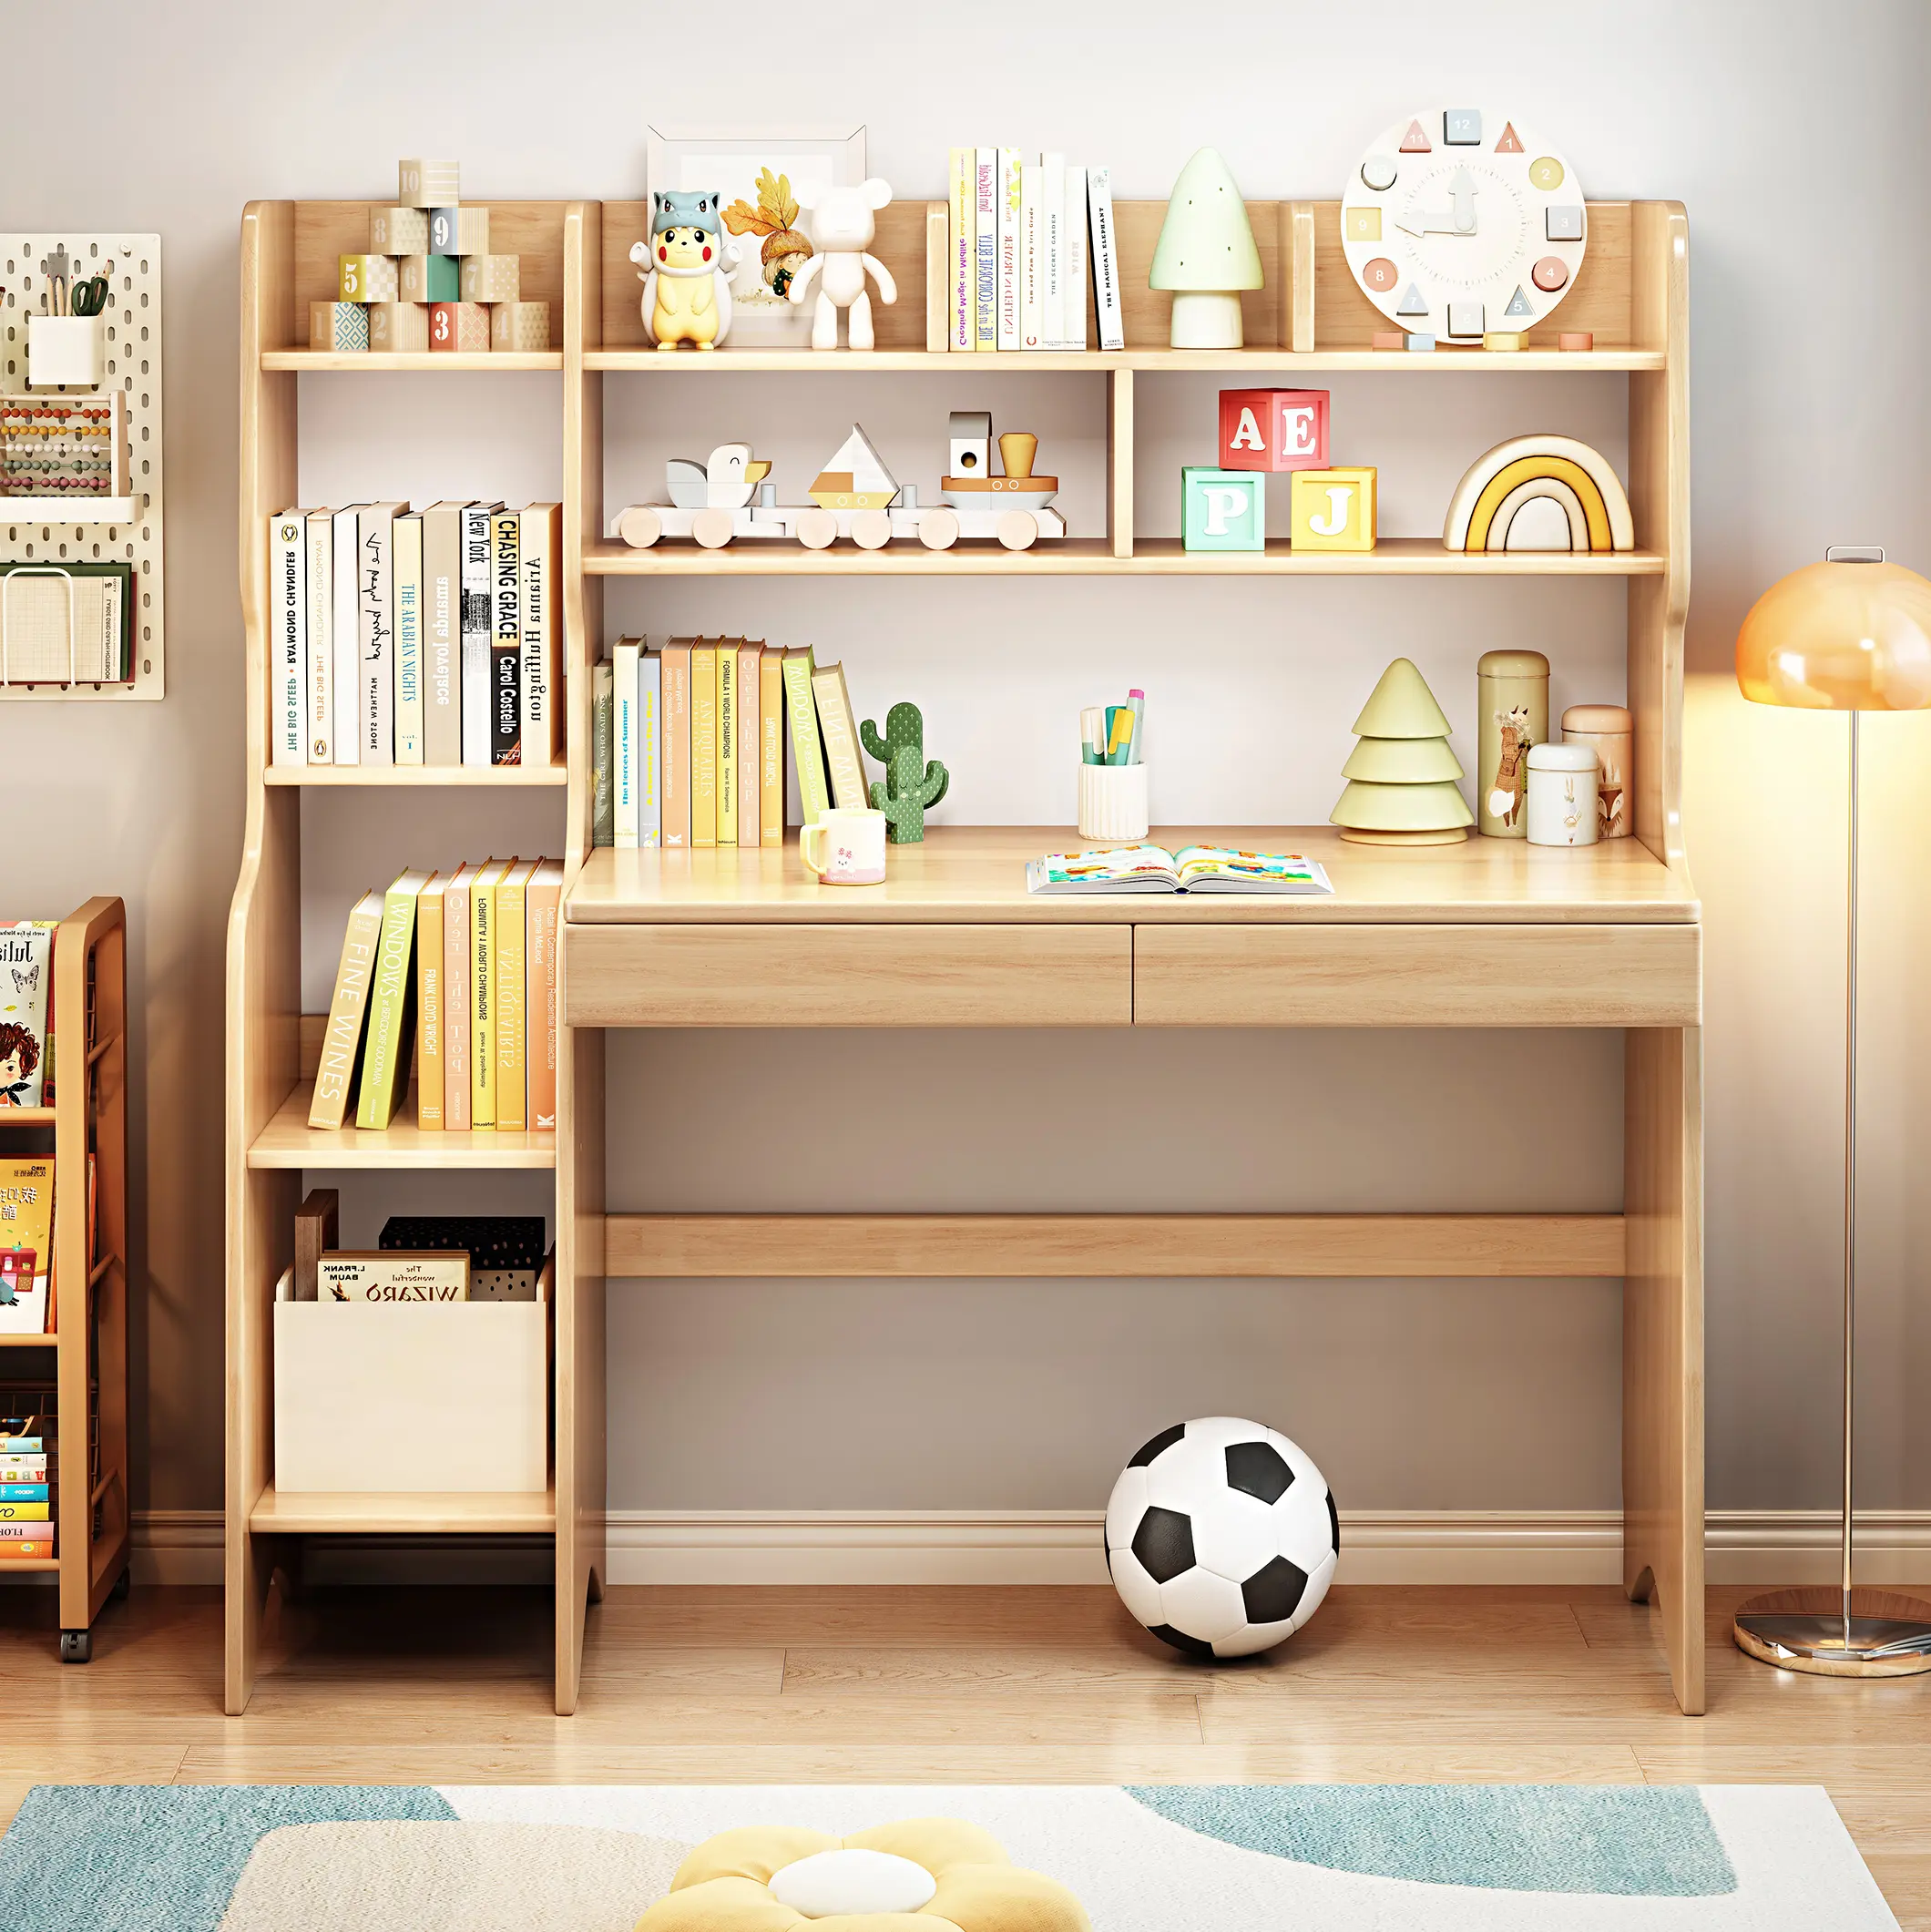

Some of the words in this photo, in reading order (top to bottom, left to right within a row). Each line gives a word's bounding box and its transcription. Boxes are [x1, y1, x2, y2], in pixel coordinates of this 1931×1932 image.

[1408, 134, 1425, 144] 11
[1454, 118, 1471, 130] 12
[1504, 138, 1515, 149] 1
[400, 169, 420, 193] 10
[1540, 168, 1551, 180] 2
[373, 218, 387, 243] 8
[434, 215, 450, 247] 9
[1098, 207, 1108, 250] ELEPHANT
[1357, 218, 1367, 231] 9
[1560, 217, 1569, 229] 3
[1071, 240, 1080, 275] WISH
[1102, 252, 1111, 289] MAGICAL
[1545, 267, 1556, 278] 4
[343, 262, 358, 294] 5
[404, 264, 418, 291] 6
[465, 264, 477, 293] 7
[1375, 269, 1384, 282] 8
[1408, 296, 1418, 306] 7
[1513, 300, 1523, 312] 5
[314, 311, 324, 341] 1
[373, 311, 387, 341] 2
[434, 310, 450, 342] 3
[493, 310, 509, 341] 4
[1229, 406, 1267, 452] A
[1281, 405, 1316, 456] E
[467, 512, 490, 538] New
[1200, 486, 1249, 537] P
[1308, 486, 1354, 537] J
[467, 538, 491, 565] York
[496, 519, 518, 588] CHASING
[401, 583, 415, 607] THE
[401, 608, 417, 655] ARABIAN
[496, 592, 518, 640] GRACE
[402, 656, 417, 703] NIGHTS
[498, 656, 517, 695] Carol
[722, 660, 731, 691] FORMULA
[742, 659, 754, 705] Over
[498, 696, 517, 735] Costello
[722, 697, 731, 721] WORLD
[622, 743, 629, 752] of
[698, 700, 714, 799] ANTIQUAIRES
[722, 721, 731, 759] CHAMPIONS
[744, 718, 753, 751] the
[532, 907, 544, 934] Virginia
[547, 906, 557, 928] Detail
[547, 928, 557, 936] in
[379, 902, 410, 997] WINDOWS
[535, 935, 544, 964] McLeod
[546, 937, 557, 986] Contemporary
[339, 942, 370, 1003] FINE
[424, 968, 437, 995] FRANK
[382, 999, 388, 1007] at
[424, 996, 437, 1022] LLOYD
[547, 987, 557, 1027] Residential
[378, 1007, 392, 1045] BERGDORF
[424, 1023, 437, 1057] WRIGHT
[320, 1014, 357, 1101] WINES
[547, 1027, 557, 1070] Architecture
[372, 1044, 386, 1087] GOODMAN
